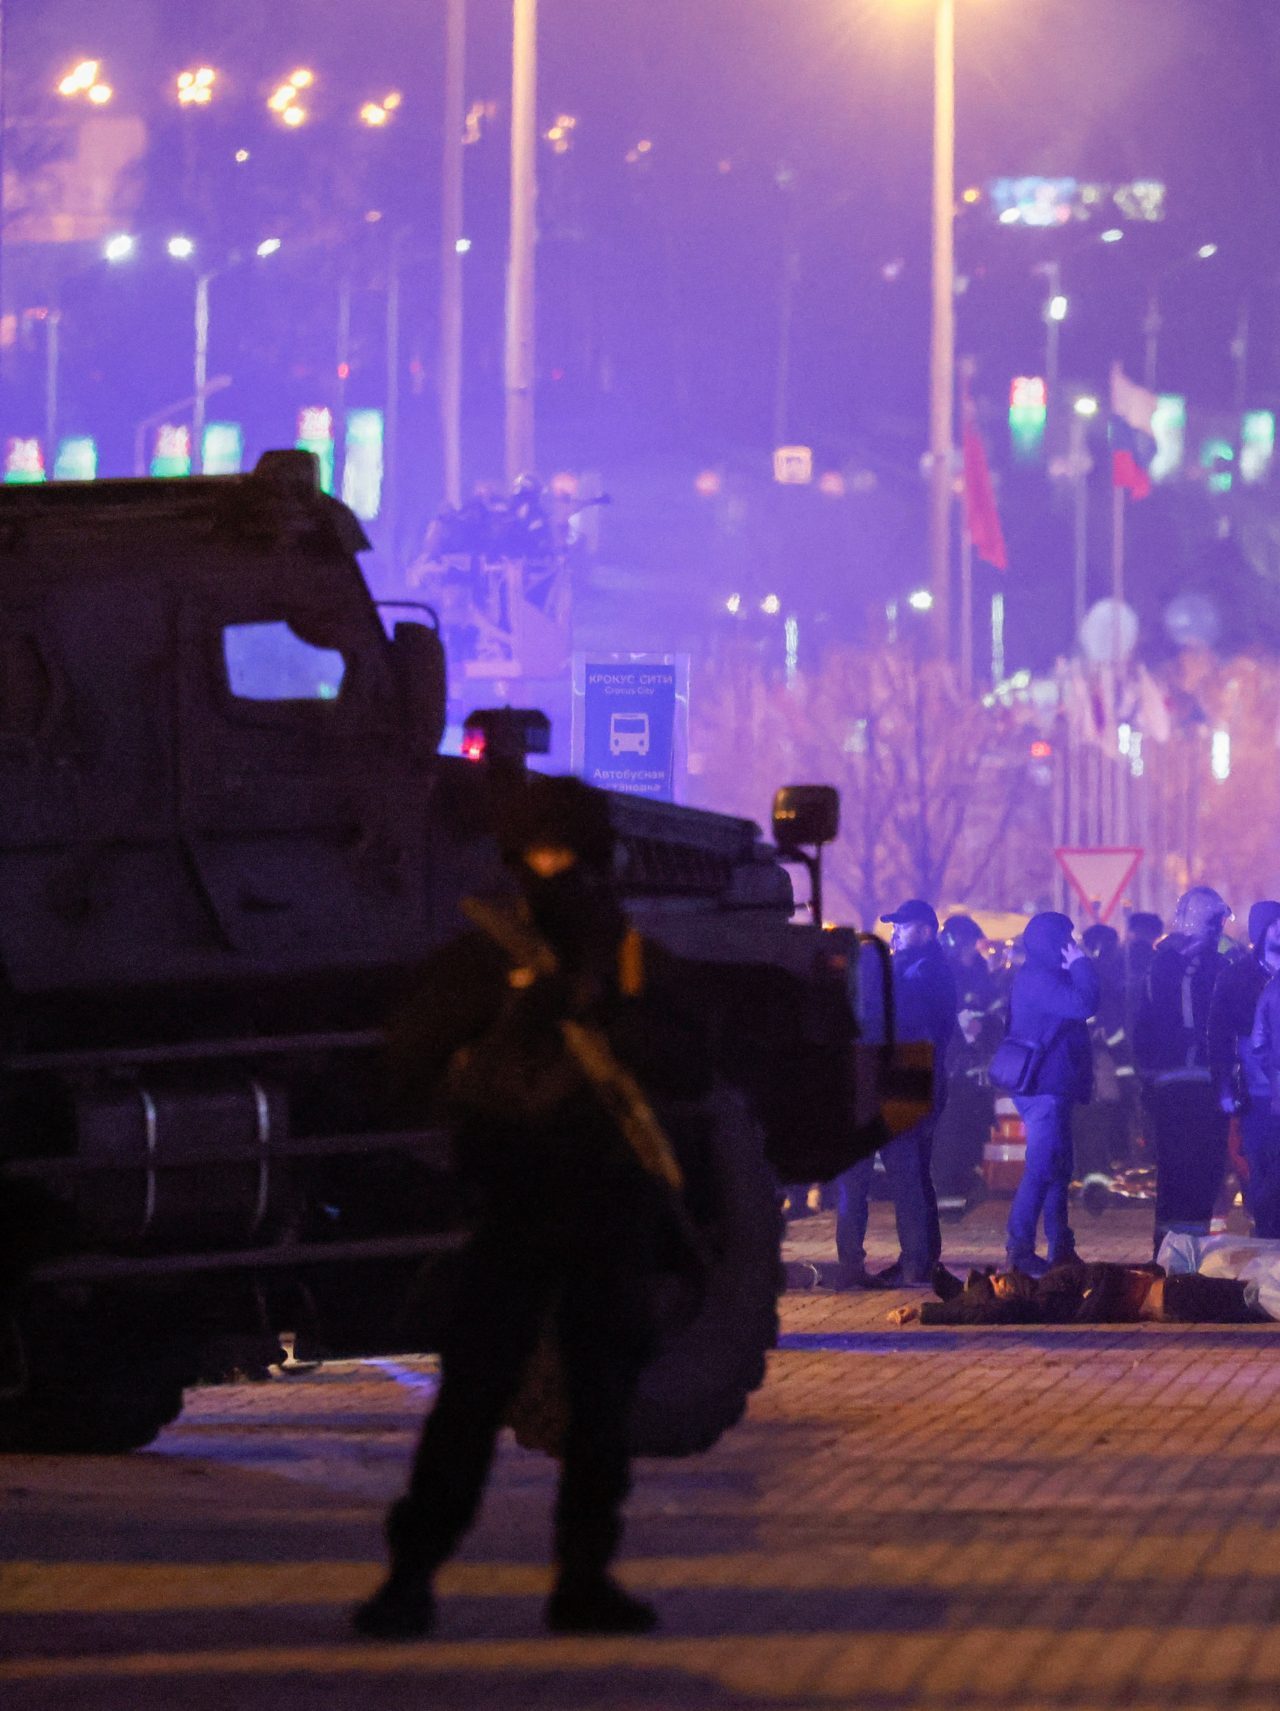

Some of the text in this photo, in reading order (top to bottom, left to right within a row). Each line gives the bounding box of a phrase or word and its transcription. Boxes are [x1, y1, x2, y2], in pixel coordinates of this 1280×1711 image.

[589, 675, 673, 685] КРОКУС СИТИ
[593, 768, 665, 780] Автобусная
